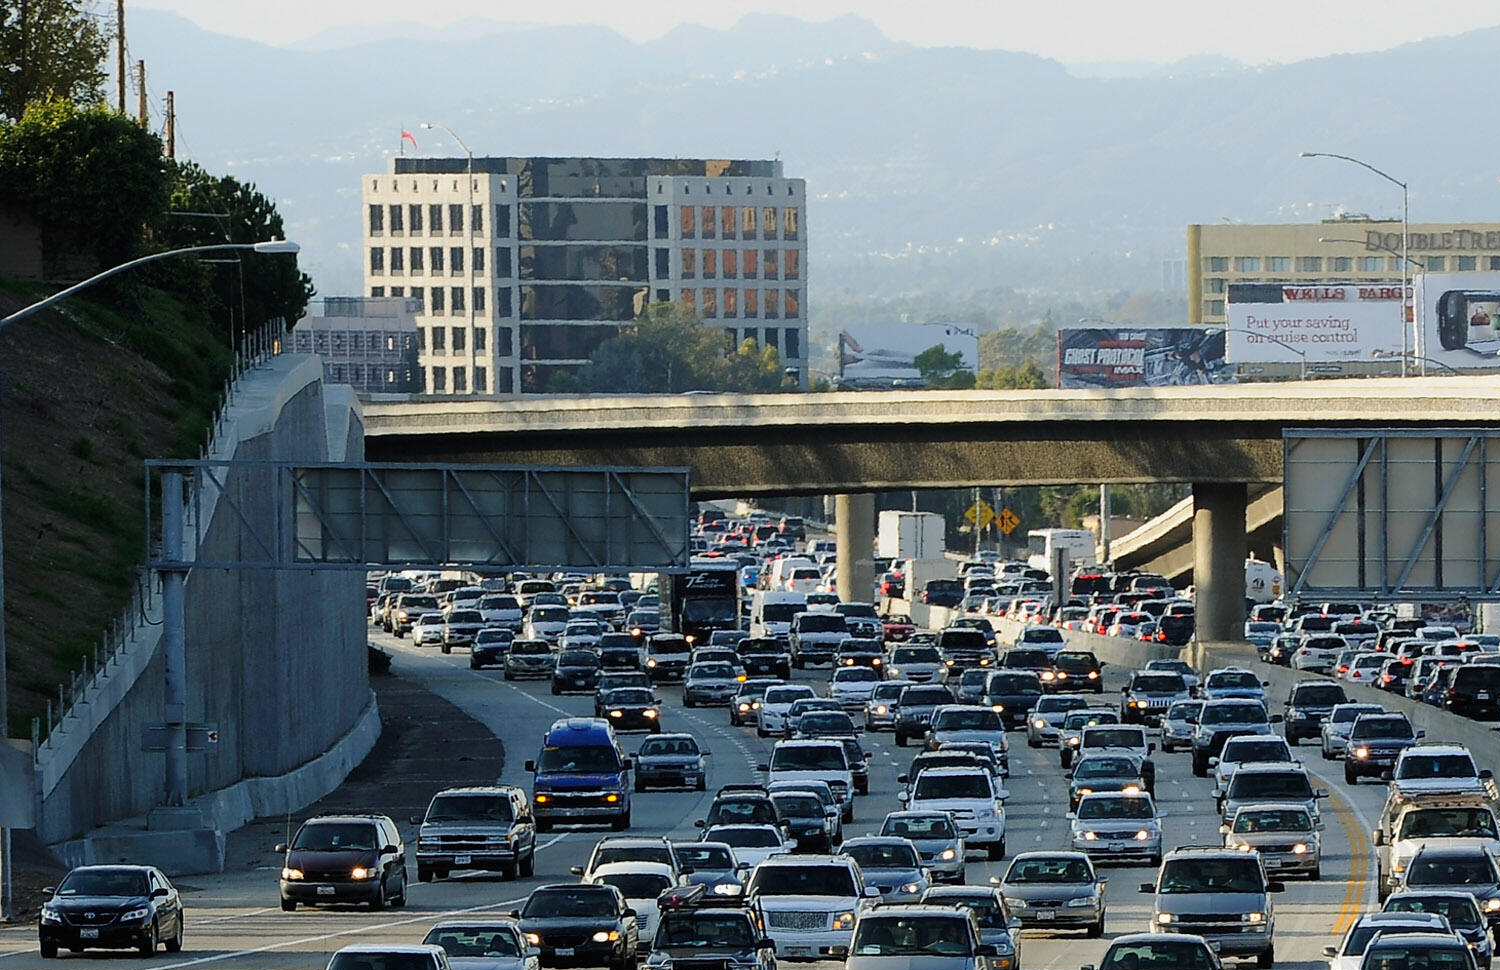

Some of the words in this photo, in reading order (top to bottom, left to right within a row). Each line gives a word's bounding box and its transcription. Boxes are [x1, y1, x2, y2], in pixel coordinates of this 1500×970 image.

[1284, 287, 1346, 300] WELLS
[1358, 287, 1414, 300] FARGO
[1246, 316, 1270, 329] Put
[1272, 319, 1302, 331] your
[1246, 333, 1264, 344] on
[1311, 329, 1358, 343] control
[1113, 366, 1145, 375] IMAX
